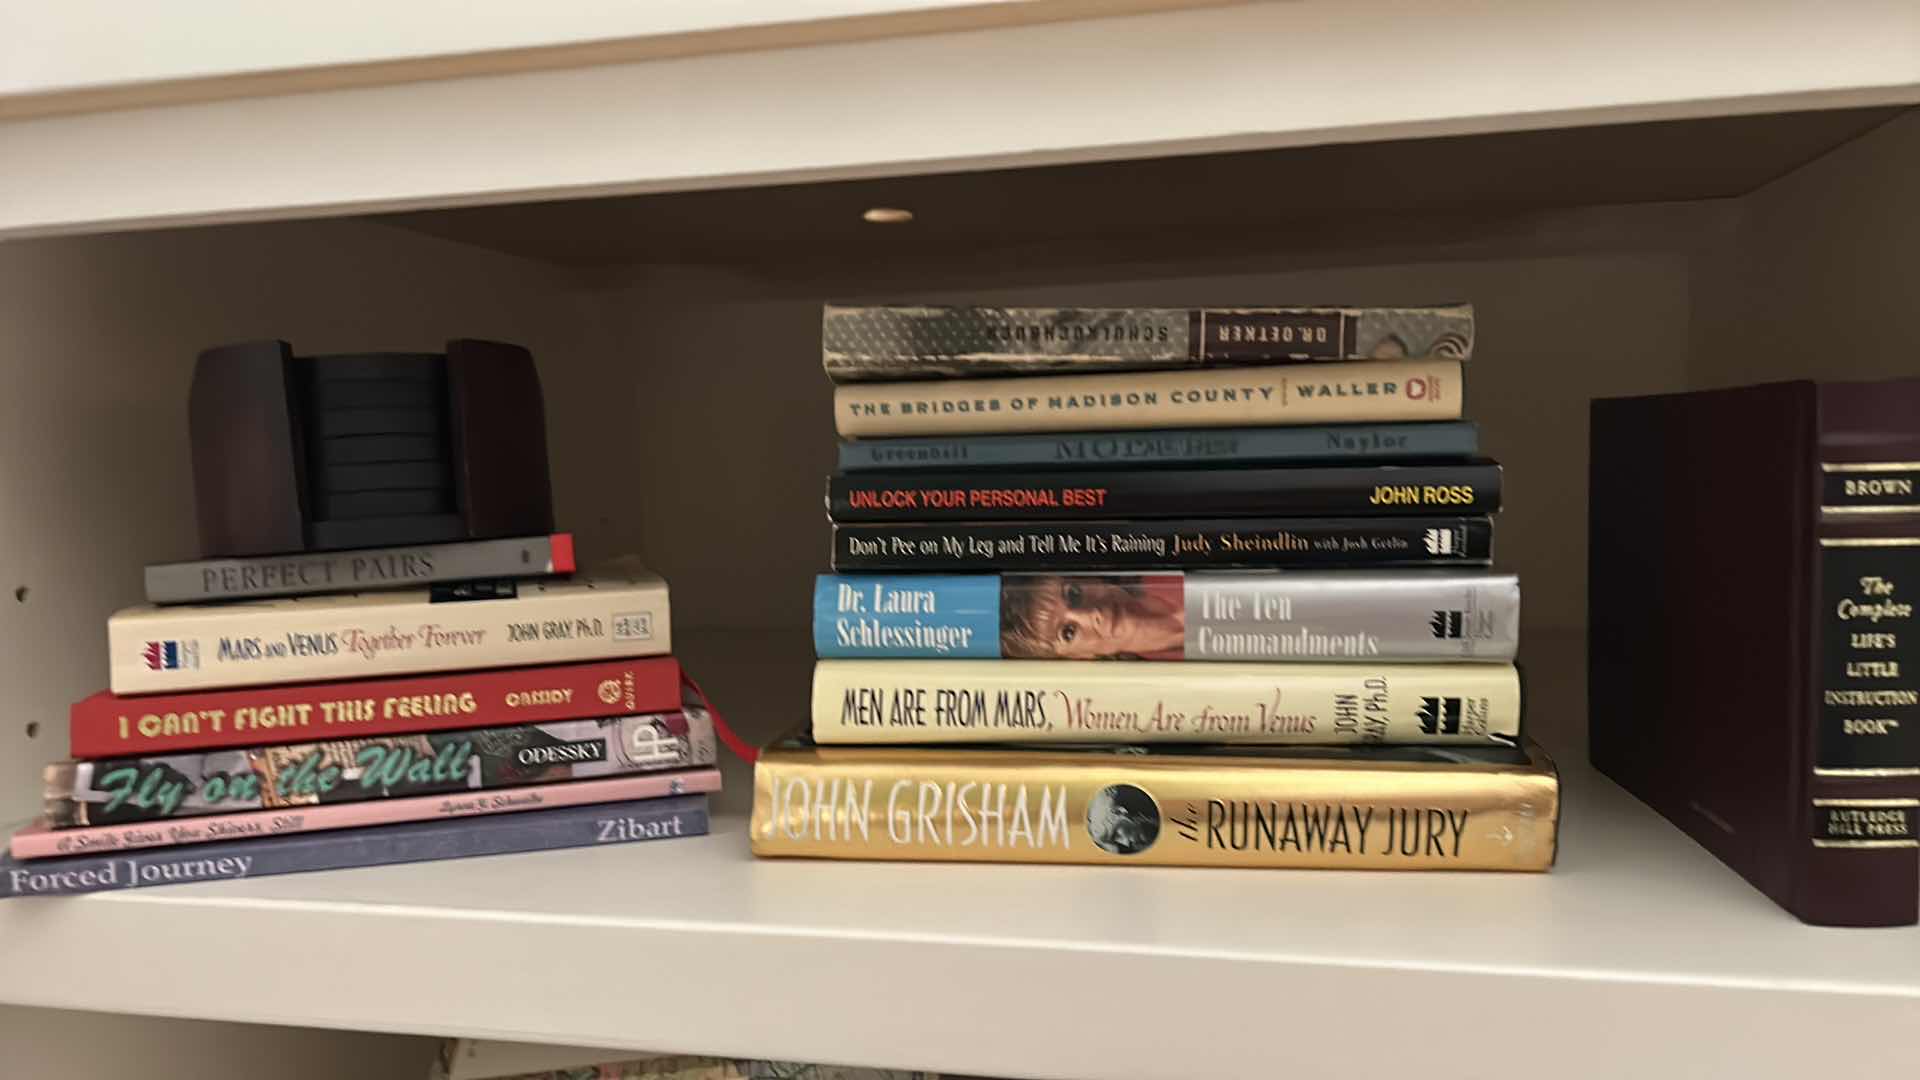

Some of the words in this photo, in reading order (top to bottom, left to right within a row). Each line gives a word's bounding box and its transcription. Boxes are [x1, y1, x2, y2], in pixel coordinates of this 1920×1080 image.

[1218, 325, 1293, 342] OETKER
[850, 403, 890, 417] THE
[901, 400, 1000, 416] BRIDGES
[1010, 398, 1038, 412] OF
[1047, 393, 1158, 410] MADISON
[1170, 387, 1274, 405] COUNTY
[1296, 382, 1399, 399] WALLER
[849, 489, 917, 509] UNLOCK
[920, 489, 966, 508] YOUR
[969, 488, 1057, 507] PERSONAL
[1062, 487, 1108, 506] BEST
[1369, 487, 1420, 505] JOHN
[1423, 486, 1474, 505] ROSS
[1844, 480, 1912, 496] BROWN
[891, 536, 916, 555] Pee
[919, 540, 938, 554] on
[941, 536, 964, 559] My
[968, 536, 994, 559] Leg
[998, 535, 1025, 553] and
[1027, 534, 1055, 553] Tell
[1057, 534, 1081, 553] Me
[1111, 533, 1166, 557] Raining
[1171, 534, 1211, 557] Judy
[1219, 531, 1309, 553] Sheindlin
[1313, 537, 1339, 551] with
[201, 560, 335, 593] PERFECT
[351, 552, 436, 582] PAIRS
[1860, 576, 1894, 595] The
[837, 583, 867, 614] Dr.
[873, 583, 936, 615] Laura
[1200, 592, 1242, 621] The
[1250, 593, 1294, 621] Ten
[1837, 598, 1913, 623] Complete
[217, 636, 263, 662] MARS
[287, 632, 339, 657] VENUS
[341, 625, 416, 661] Together
[507, 622, 540, 642] JOHN
[543, 619, 574, 640] GRAY
[836, 618, 974, 652] Schlessinger
[1199, 627, 1380, 656] Commandments
[1846, 662, 1899, 678] LITTLE
[840, 687, 884, 727] MEN
[889, 688, 927, 728] ARE
[934, 690, 989, 728] FROM
[992, 690, 1053, 732] MARS,
[1055, 690, 1142, 733] Women
[1140, 701, 1186, 733] Are
[1191, 705, 1250, 734] from
[1255, 687, 1318, 734] Venus
[1824, 690, 1919, 705] INSTRUCTION
[118, 716, 129, 739] I
[136, 709, 225, 738] CAN'T
[234, 702, 313, 732] FIGHT
[319, 698, 376, 723] THIS
[383, 691, 478, 720] FEELING
[1334, 693, 1359, 734] JOHN
[517, 742, 605, 766] ODESSKY
[99, 766, 186, 816] Fly
[202, 772, 262, 802] on
[275, 752, 342, 799] the
[355, 739, 475, 790] Wall
[766, 774, 876, 842] JOHN
[888, 778, 1070, 850] GRISHAM
[597, 815, 683, 842] Zibart
[1206, 798, 1376, 855] RUNAWAY
[1381, 805, 1468, 857] JURY
[9, 862, 119, 894] Forced
[124, 856, 253, 888] Journey
